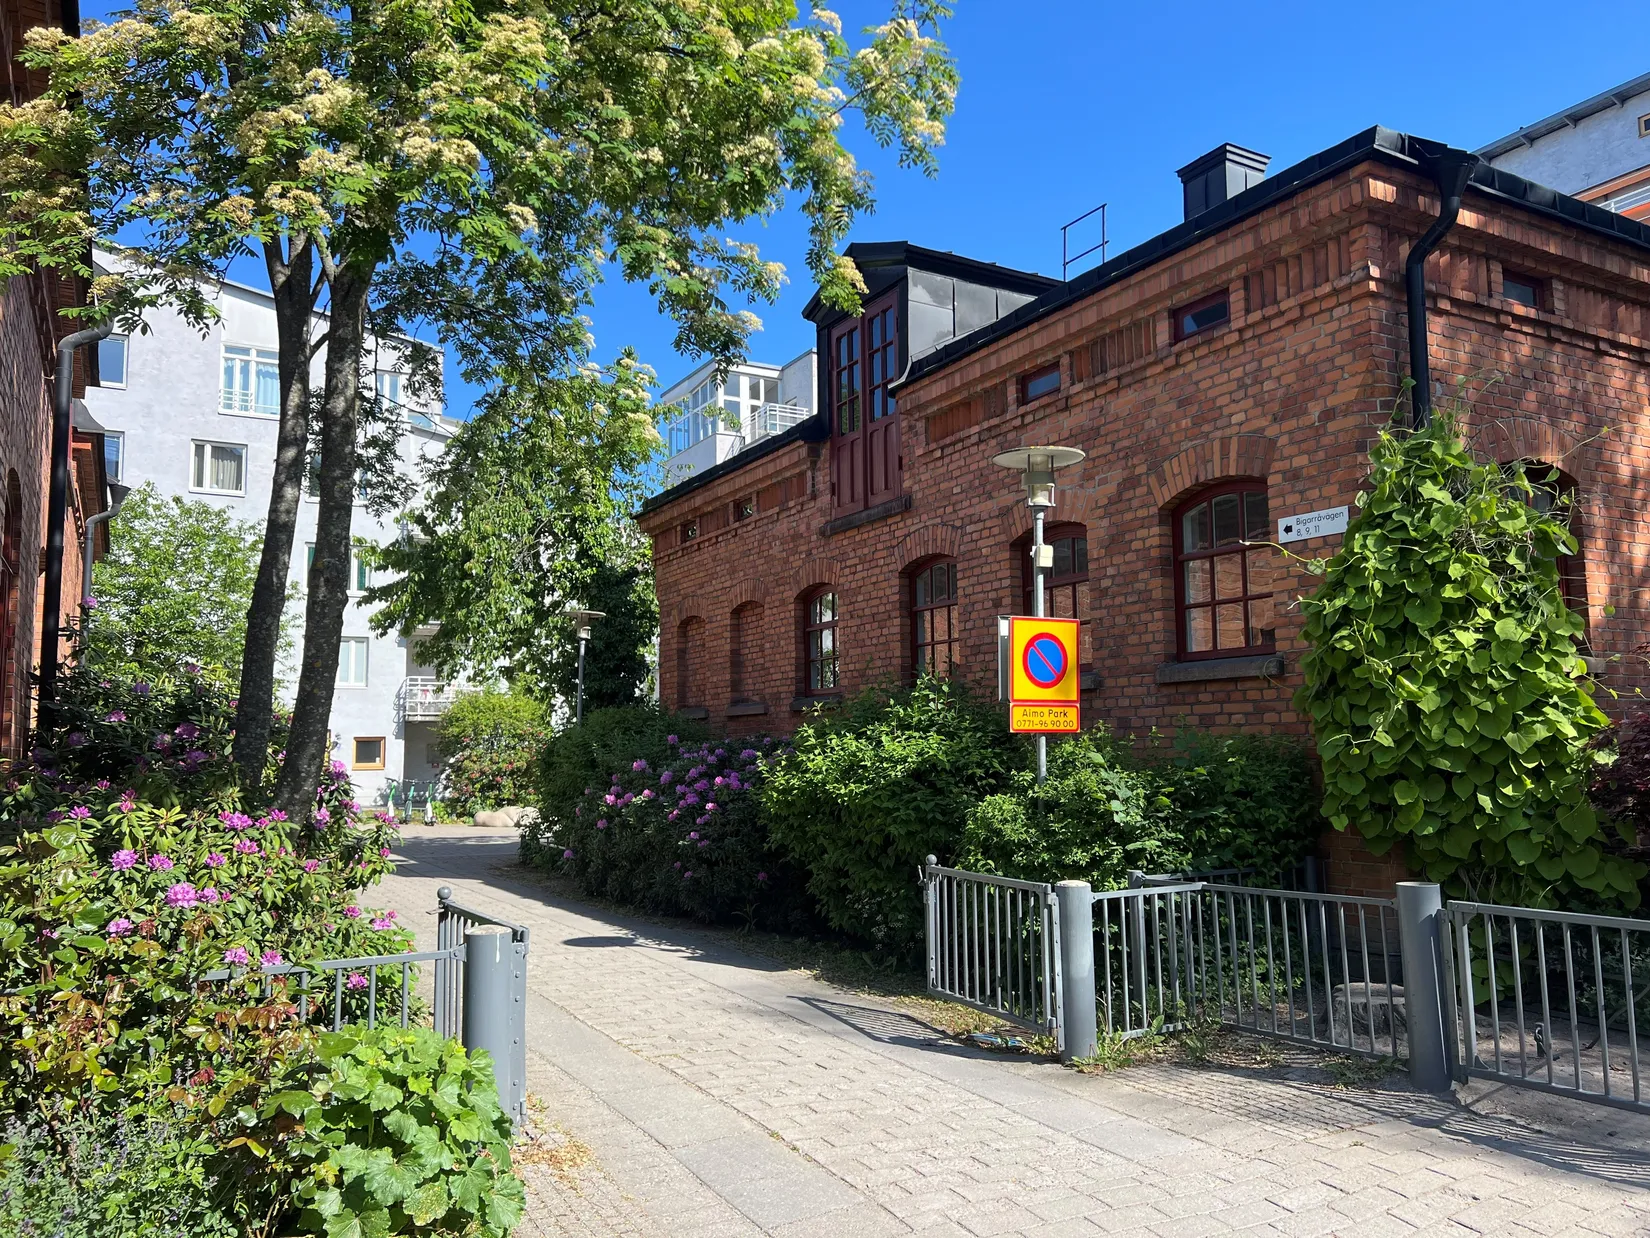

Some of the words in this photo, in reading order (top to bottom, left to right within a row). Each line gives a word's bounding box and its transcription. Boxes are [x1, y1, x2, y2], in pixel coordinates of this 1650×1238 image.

[1296, 511, 1344, 526] Bigarråvägen
[1022, 709, 1045, 718] Aimo
[1048, 709, 1068, 718] Park
[1016, 720, 1048, 728] 0771-96
[1051, 720, 1062, 728] 90
[1063, 720, 1074, 728] 00
